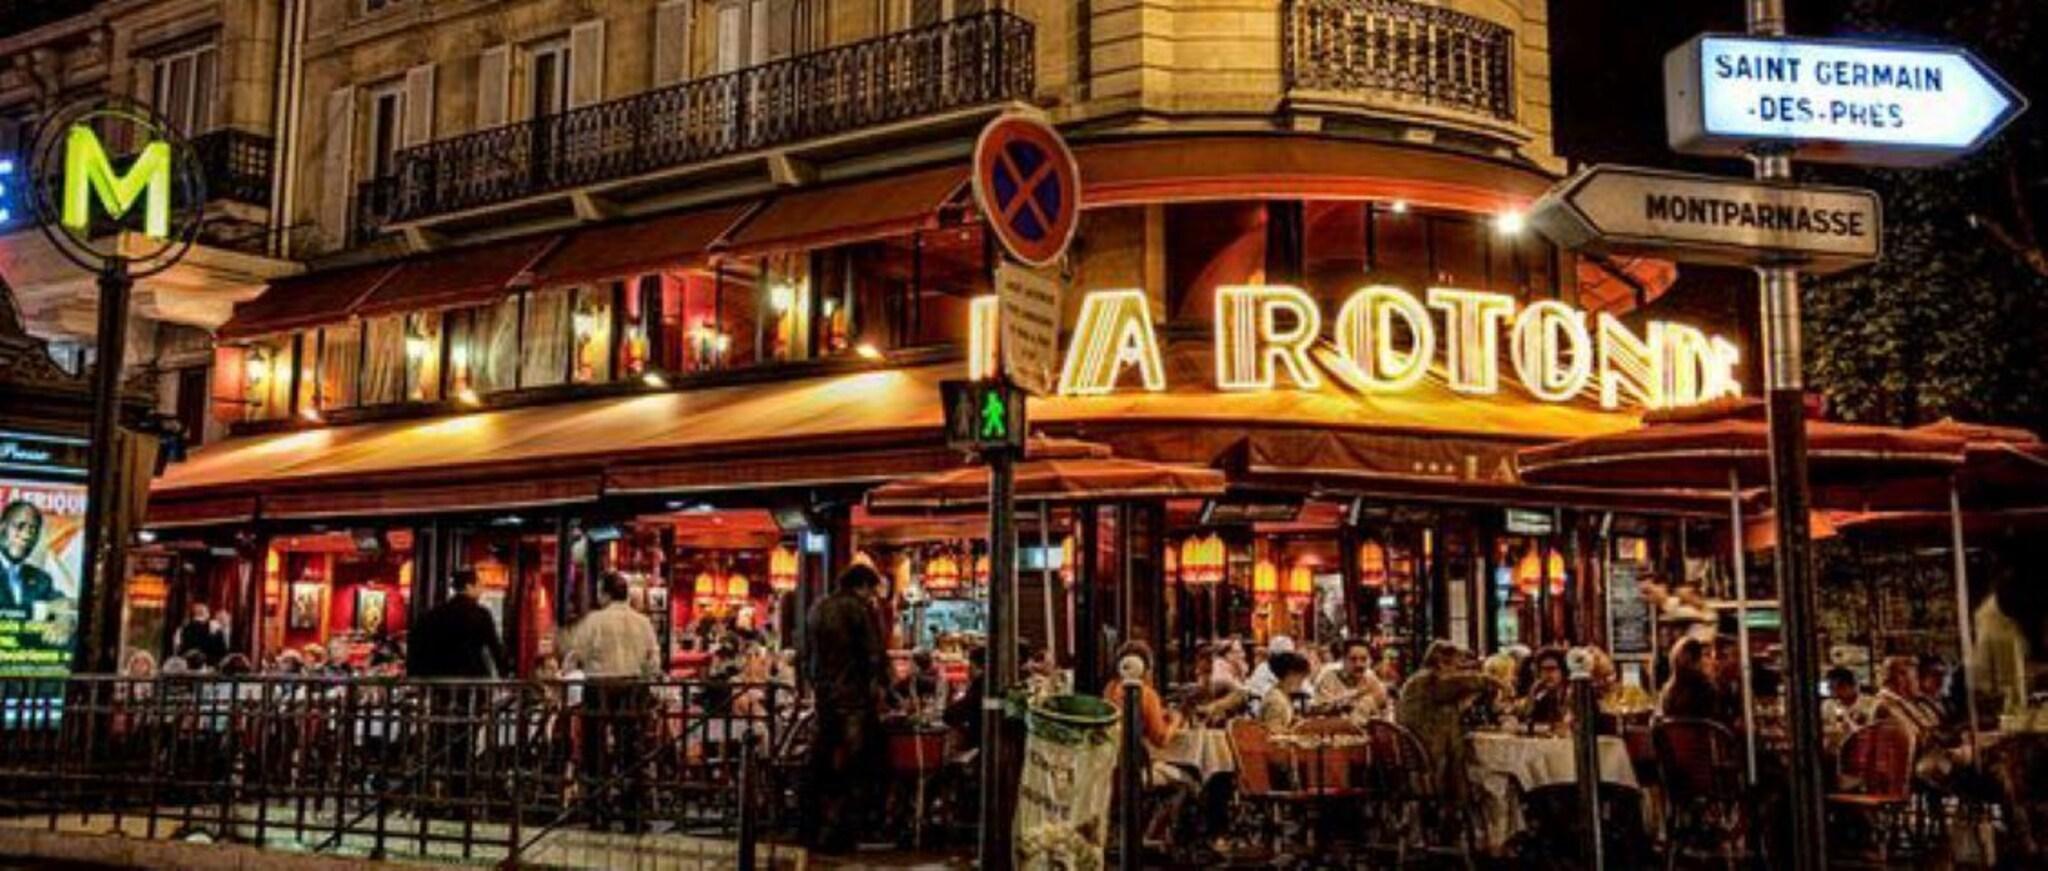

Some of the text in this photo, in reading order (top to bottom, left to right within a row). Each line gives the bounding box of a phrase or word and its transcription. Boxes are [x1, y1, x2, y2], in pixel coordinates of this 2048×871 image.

[1715, 54, 1943, 92] SAINT GERMAIN
[63, 125, 170, 238] M
[1645, 194, 1864, 236] MONTPARNASSE
[1214, 284, 1742, 409] ROTONDE
